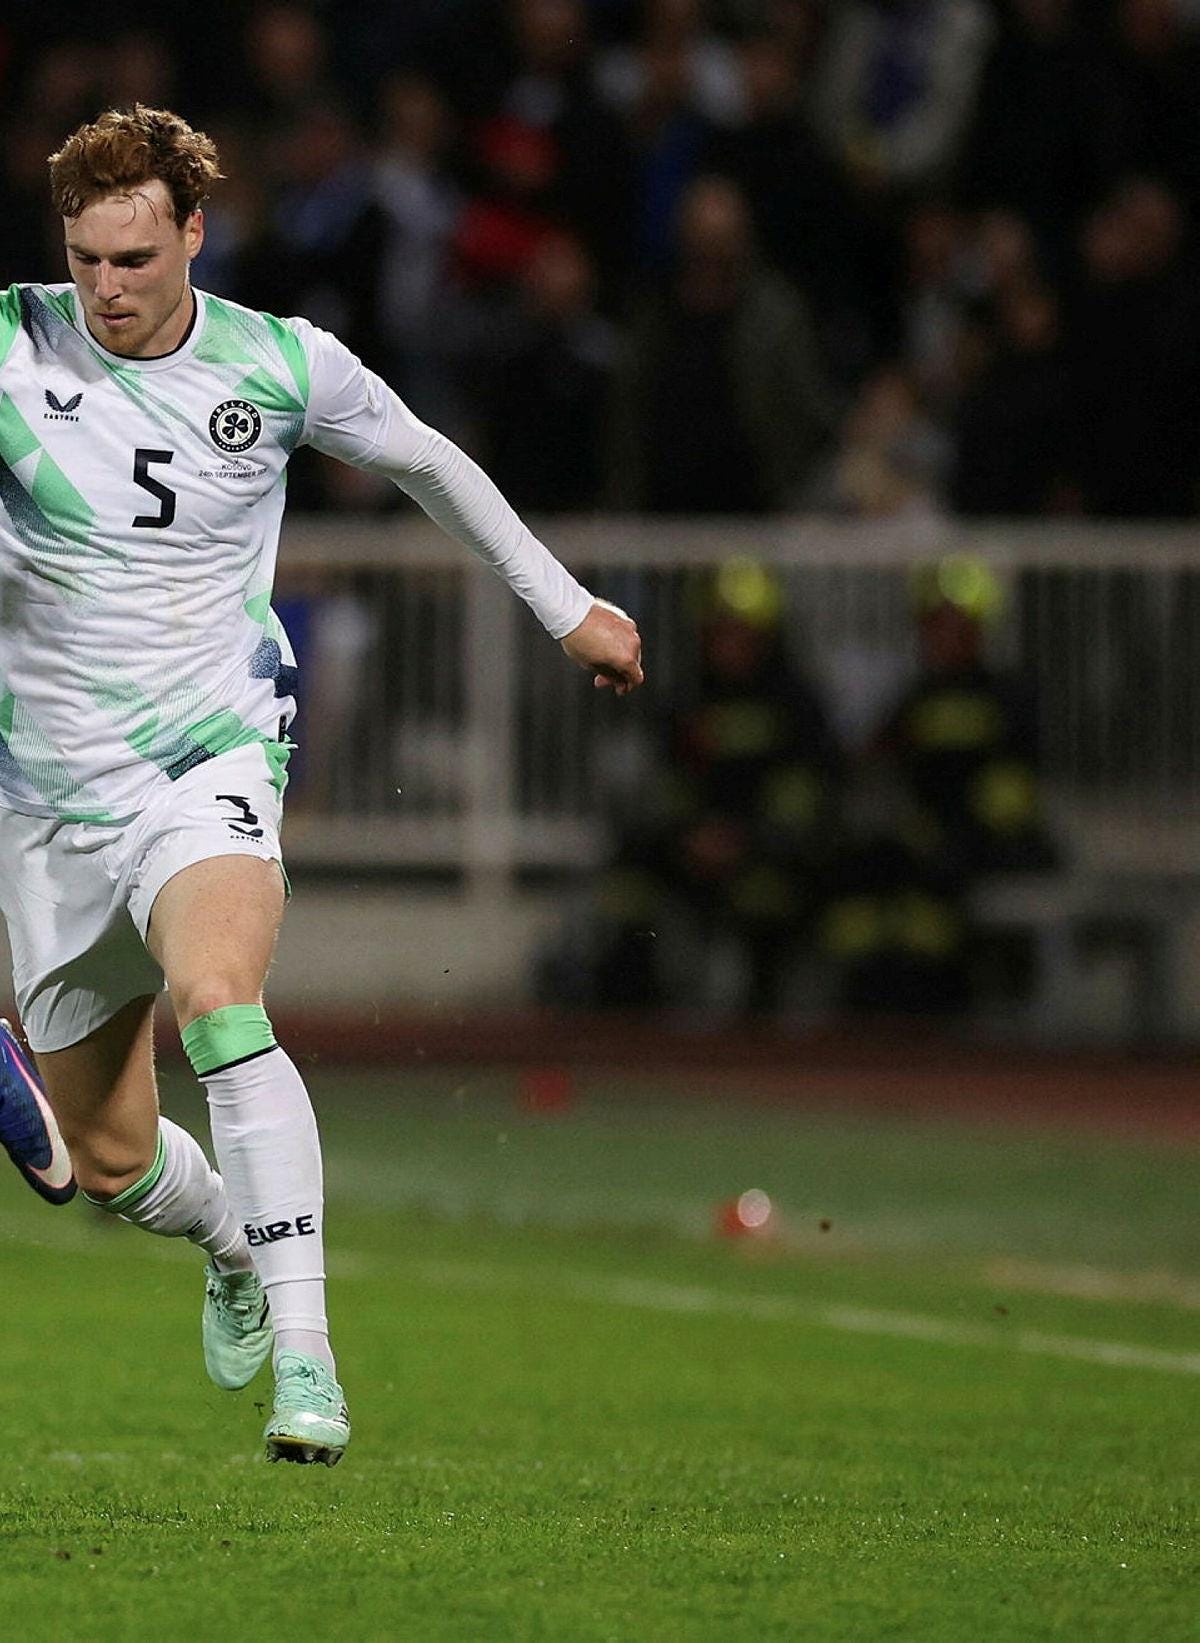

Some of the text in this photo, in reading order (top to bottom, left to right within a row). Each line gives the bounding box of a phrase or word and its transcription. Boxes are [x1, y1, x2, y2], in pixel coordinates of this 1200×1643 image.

[43, 413, 80, 422] CASTORE
[212, 401, 258, 419] IRELAND
[132, 448, 176, 528] 5
